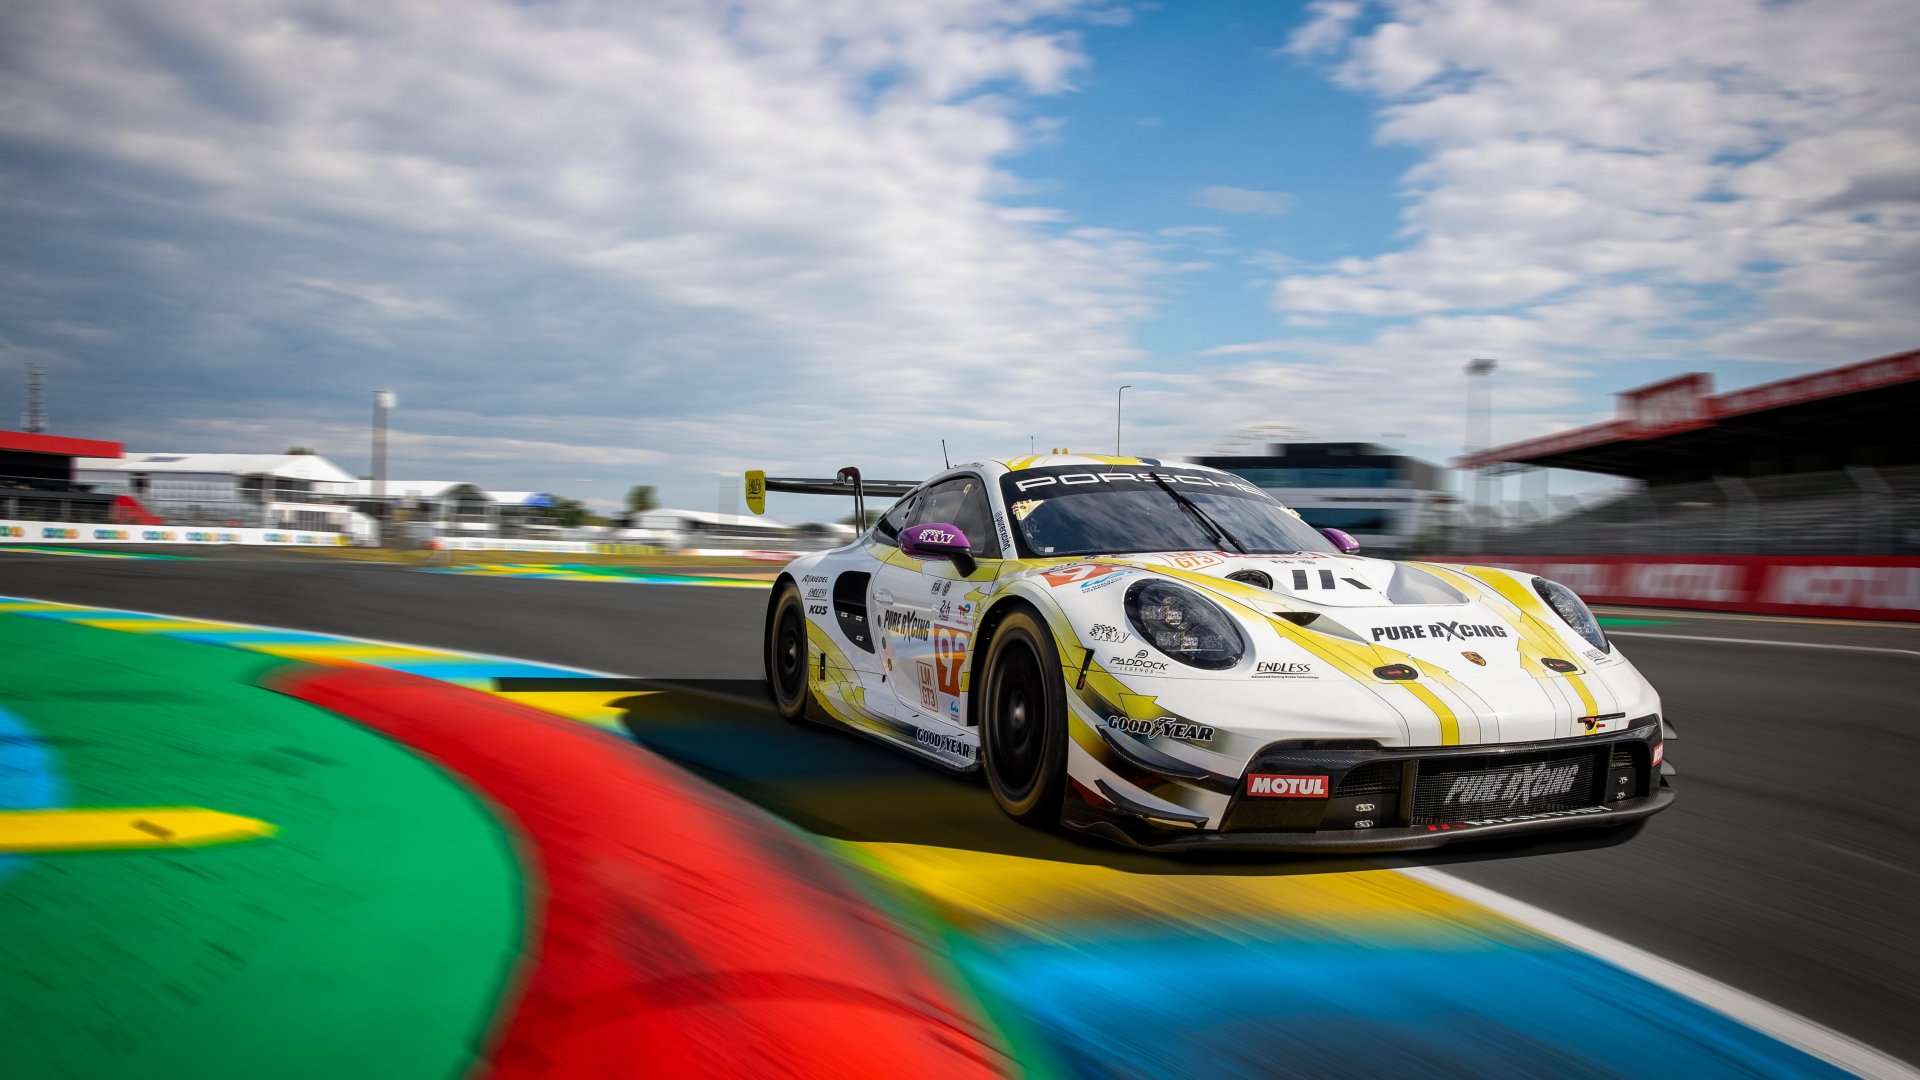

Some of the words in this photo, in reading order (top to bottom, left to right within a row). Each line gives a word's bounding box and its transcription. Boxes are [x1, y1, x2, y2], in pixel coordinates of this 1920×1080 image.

[1016, 472, 1271, 497] PORSCHE
[1174, 555, 1215, 569] GT3
[883, 609, 901, 632] PURE
[1094, 628, 1131, 643] KW
[1371, 626, 1425, 642] PURE
[1110, 656, 1169, 671] PADDOCK
[1119, 666, 1155, 674] LEGENDS
[1256, 662, 1311, 673] ENDLESS
[921, 685, 936, 708] GT3
[1108, 717, 1215, 742] GOODYEAR
[916, 727, 970, 759] GOODYEAR
[1251, 777, 1325, 795] MOTUL
[1443, 774, 1509, 805] PURE
